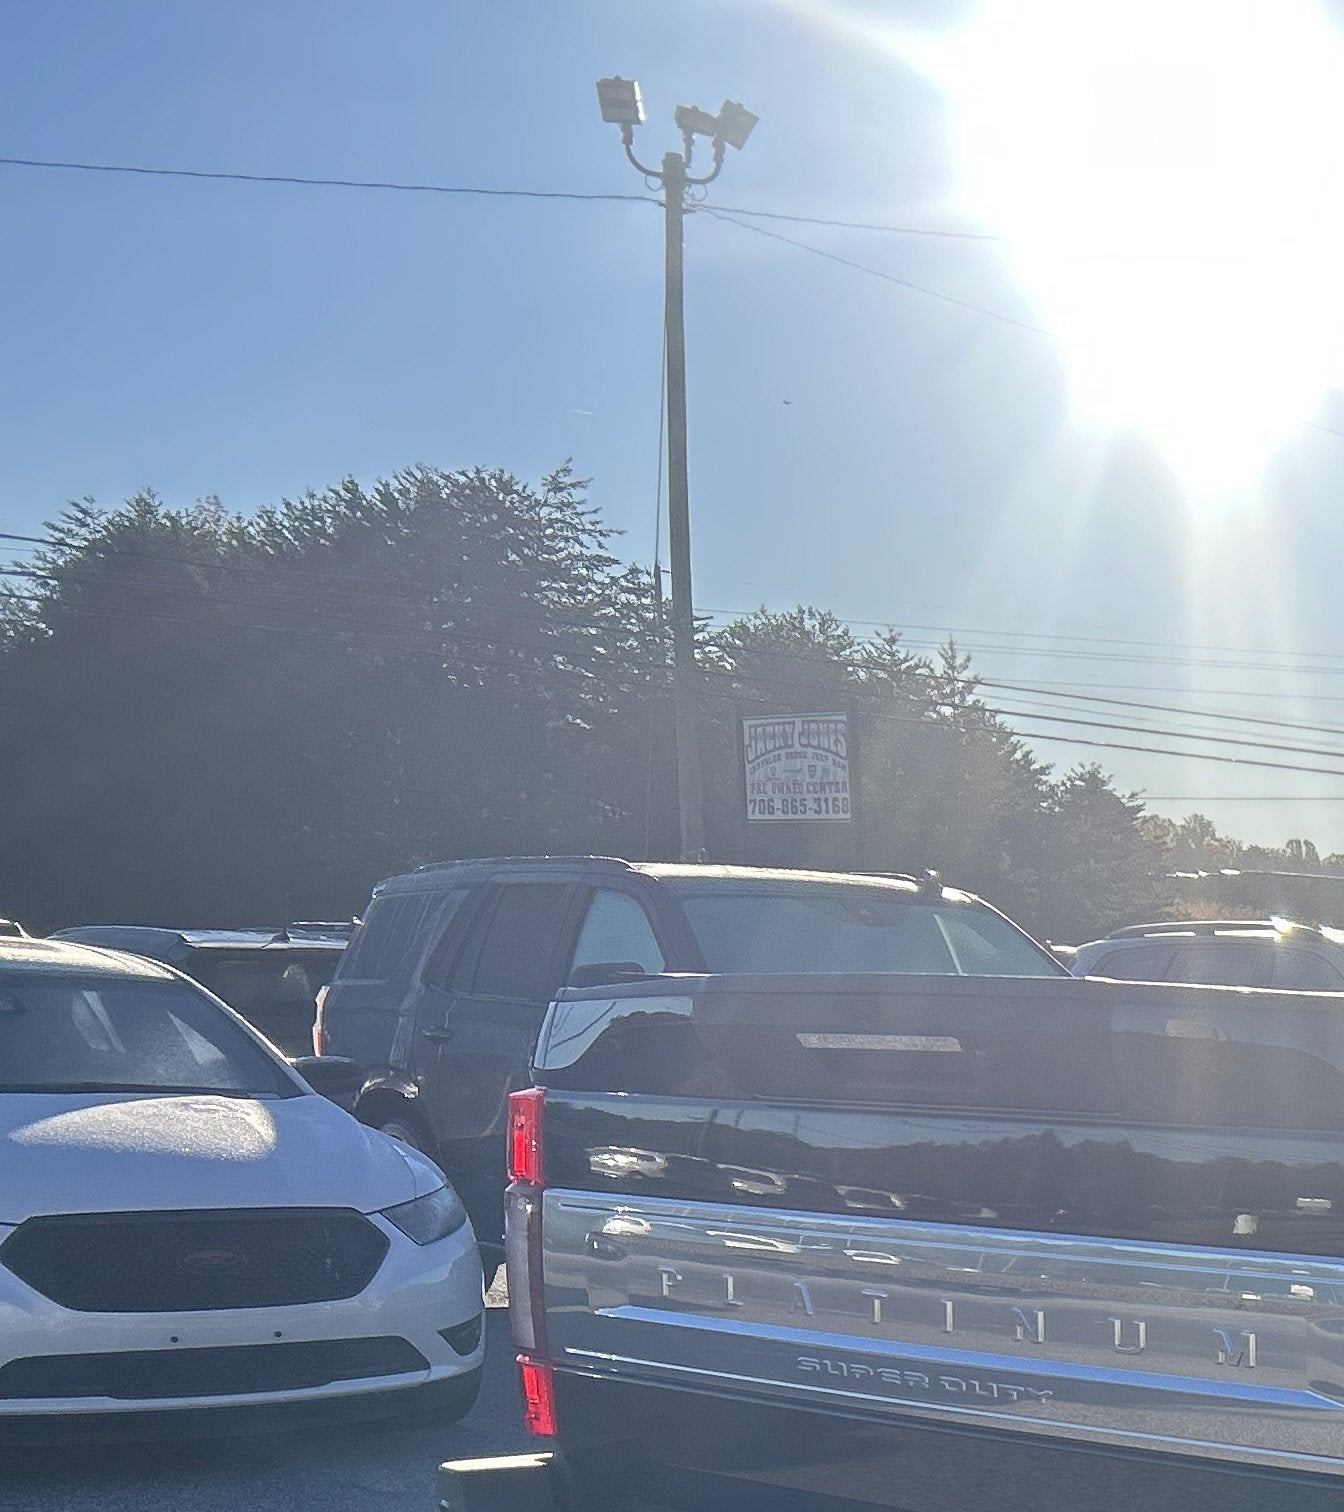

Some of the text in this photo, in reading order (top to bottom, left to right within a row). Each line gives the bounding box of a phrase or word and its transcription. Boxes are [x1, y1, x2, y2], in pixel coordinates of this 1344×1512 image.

[747, 720, 848, 764] JACKY JONES
[749, 797, 850, 815] 706-865-3168
[751, 781, 849, 795] PRE OWNED CENTER
[656, 1264, 1257, 1369] PLATINUM
[796, 1355, 1054, 1405] SUPER DUTY
